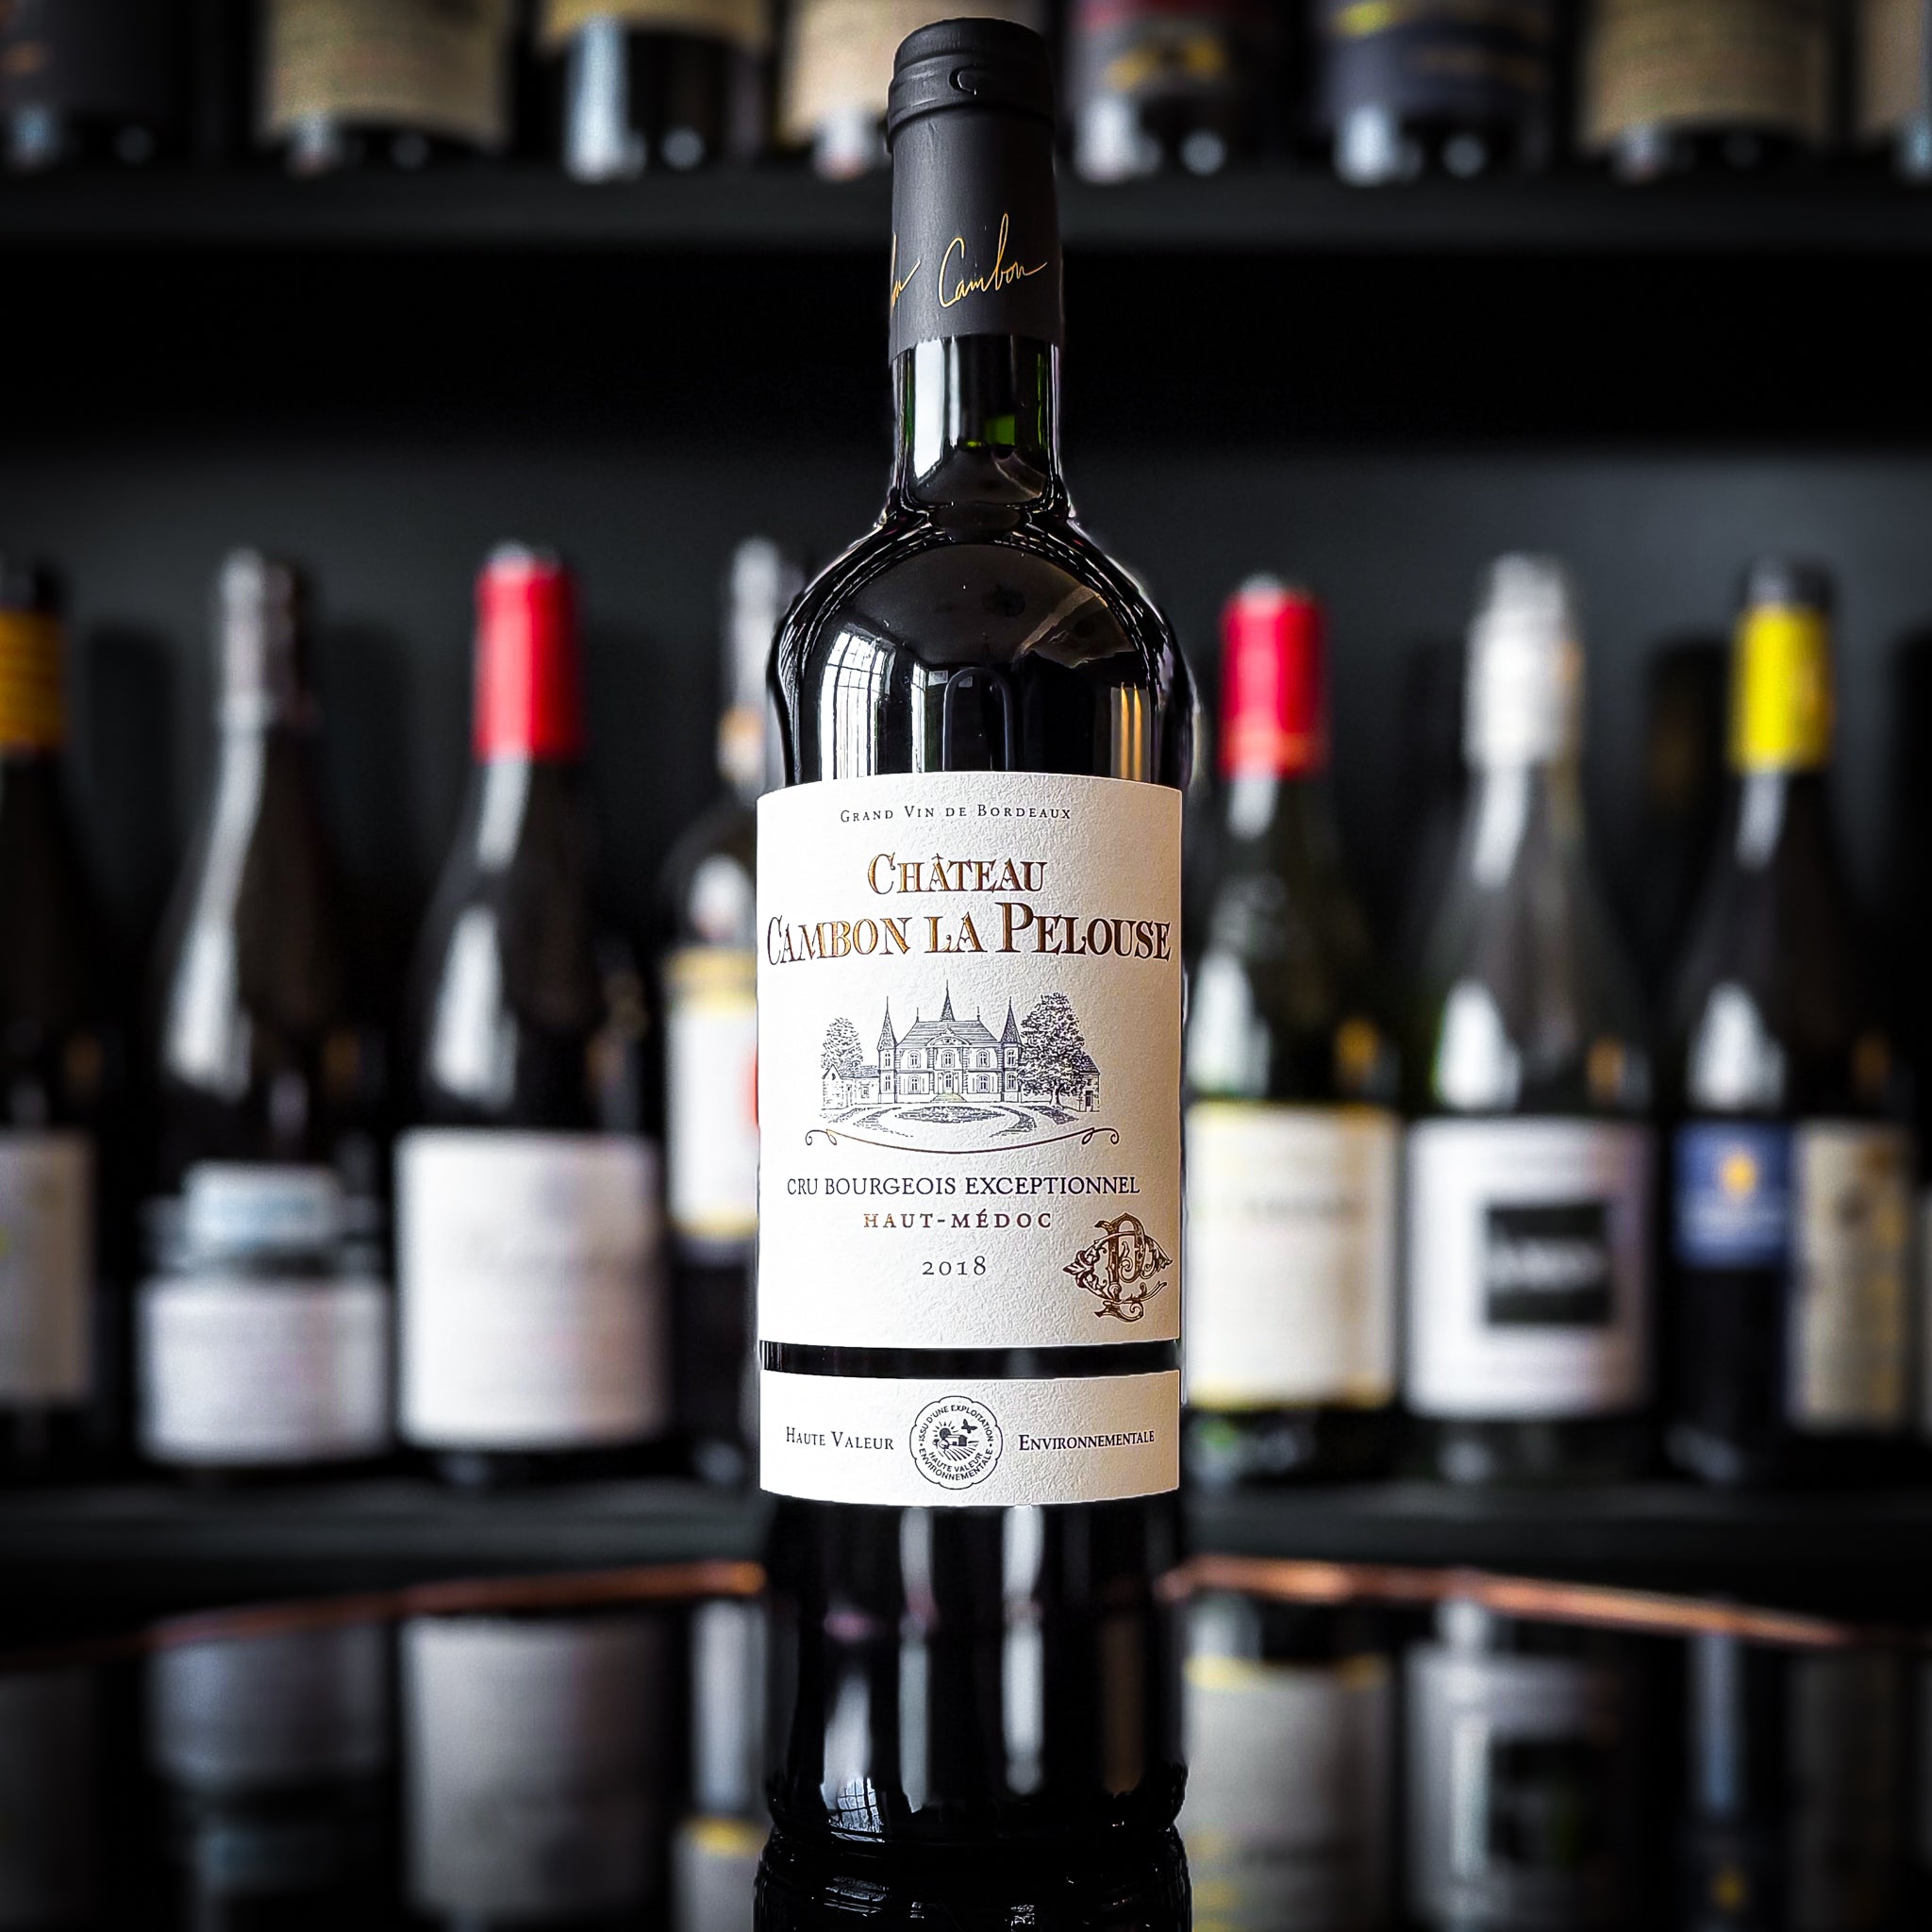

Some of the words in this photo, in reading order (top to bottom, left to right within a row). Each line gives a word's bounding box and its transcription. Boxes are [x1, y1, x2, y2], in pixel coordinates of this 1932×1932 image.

[938, 213, 1048, 308] Cambon
[841, 809, 894, 823] GRAND
[904, 806, 935, 818] VIN
[945, 807, 967, 817] DE
[977, 804, 1071, 820] BORDEAUX
[867, 852, 1048, 895] CHÂTEAU
[766, 915, 912, 967] CAMBON
[924, 910, 989, 955] LA
[993, 901, 1173, 963] PELOUSE
[787, 1177, 819, 1195] CRU
[824, 1176, 957, 1196] BOURGEOIS
[965, 1175, 1141, 1196] EXCEPTIONNEL
[863, 1208, 1053, 1229] HAUT-MÉDOC
[921, 1255, 988, 1277] 2018
[919, 1423, 929, 1441] ISSU
[925, 1406, 949, 1424] D'UNE
[951, 1405, 994, 1442] EXPLOITATION
[786, 1426, 826, 1446] HAUTE
[831, 1431, 894, 1450] VALEUR
[1018, 1430, 1155, 1451] ENVIRONNEMENTALE
[918, 1447, 993, 1481] ENVIRONNEMENTALE
[928, 1451, 952, 1473] HAUTE
[954, 1452, 984, 1473] VALEUR
